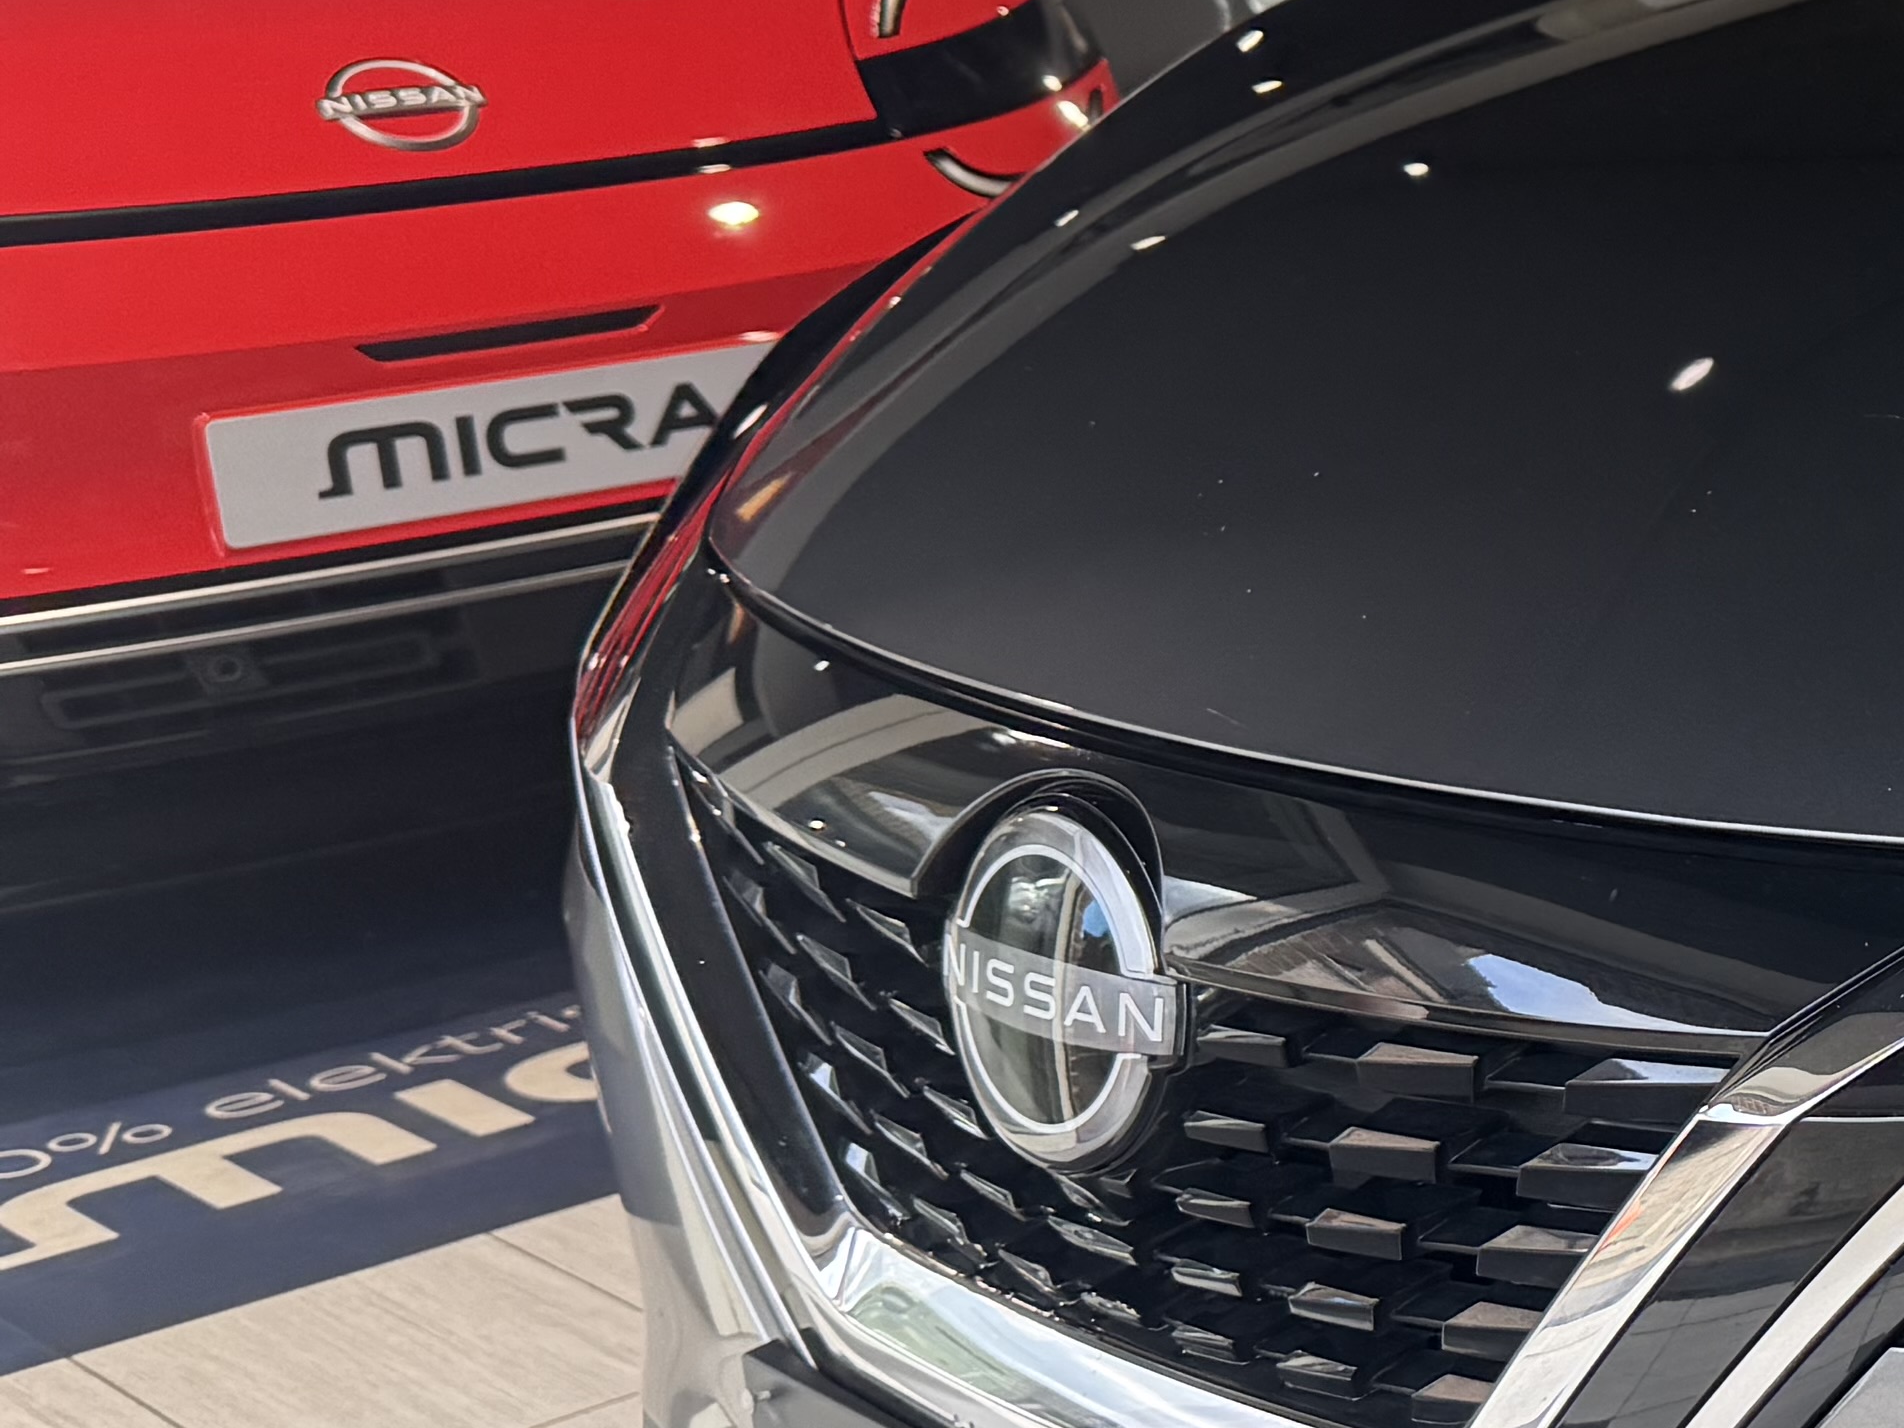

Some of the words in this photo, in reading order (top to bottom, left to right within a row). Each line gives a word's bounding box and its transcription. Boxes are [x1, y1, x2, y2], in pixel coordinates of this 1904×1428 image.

[317, 84, 487, 120] NISSAN
[318, 381, 718, 500] MICRA
[942, 933, 1165, 1043] NISSAN
